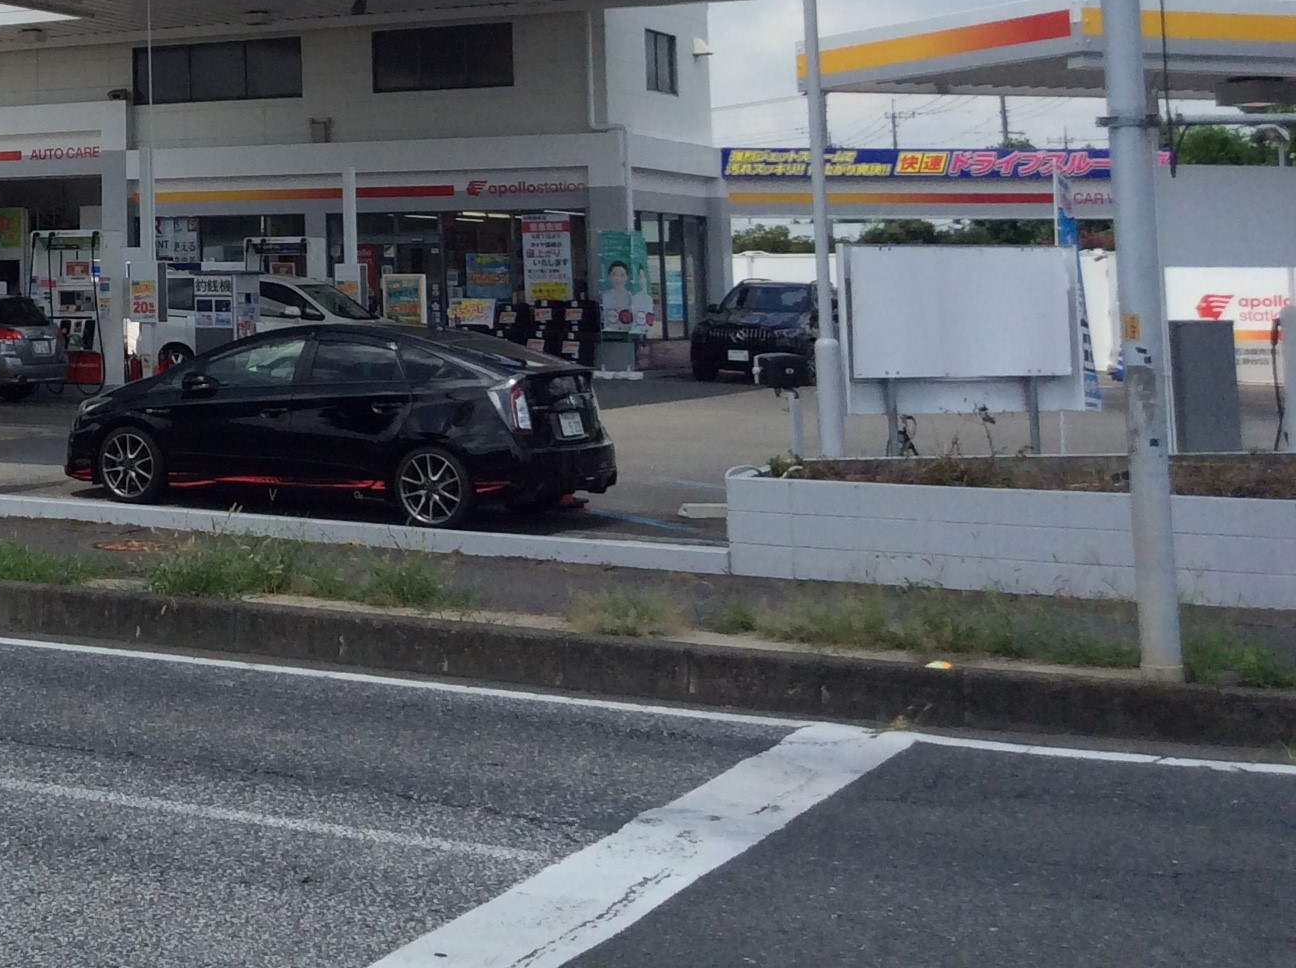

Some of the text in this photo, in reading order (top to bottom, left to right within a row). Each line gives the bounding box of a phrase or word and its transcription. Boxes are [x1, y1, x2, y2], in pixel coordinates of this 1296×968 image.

[30, 146, 100, 160] AUTO CARE
[899, 150, 1171, 176] 快速 ドライブスルー
[487, 181, 586, 197] apollostation
[1073, 193, 1105, 205] CAR
[1238, 295, 1291, 309] apollo
[1239, 311, 1281, 322] stati
